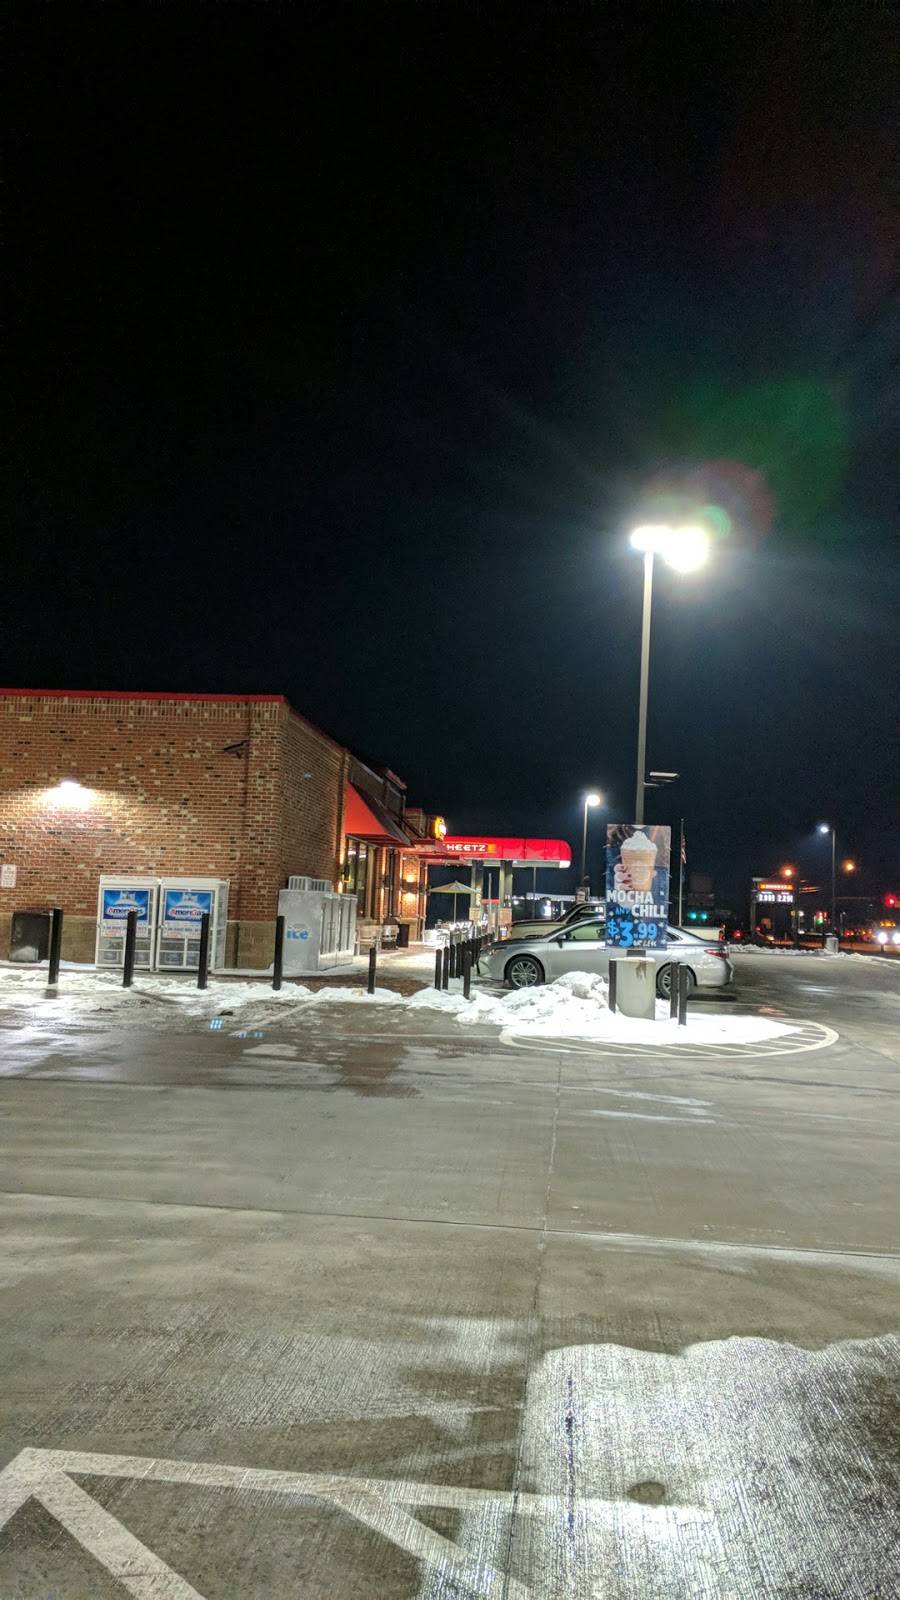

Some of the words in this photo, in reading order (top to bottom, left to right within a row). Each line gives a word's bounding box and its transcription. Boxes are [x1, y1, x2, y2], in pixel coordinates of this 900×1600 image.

[443, 844, 486, 852] HEETZ
[607, 890, 654, 904] MOCHA
[632, 904, 668, 918] CHILL
[607, 919, 657, 947] $3.99
